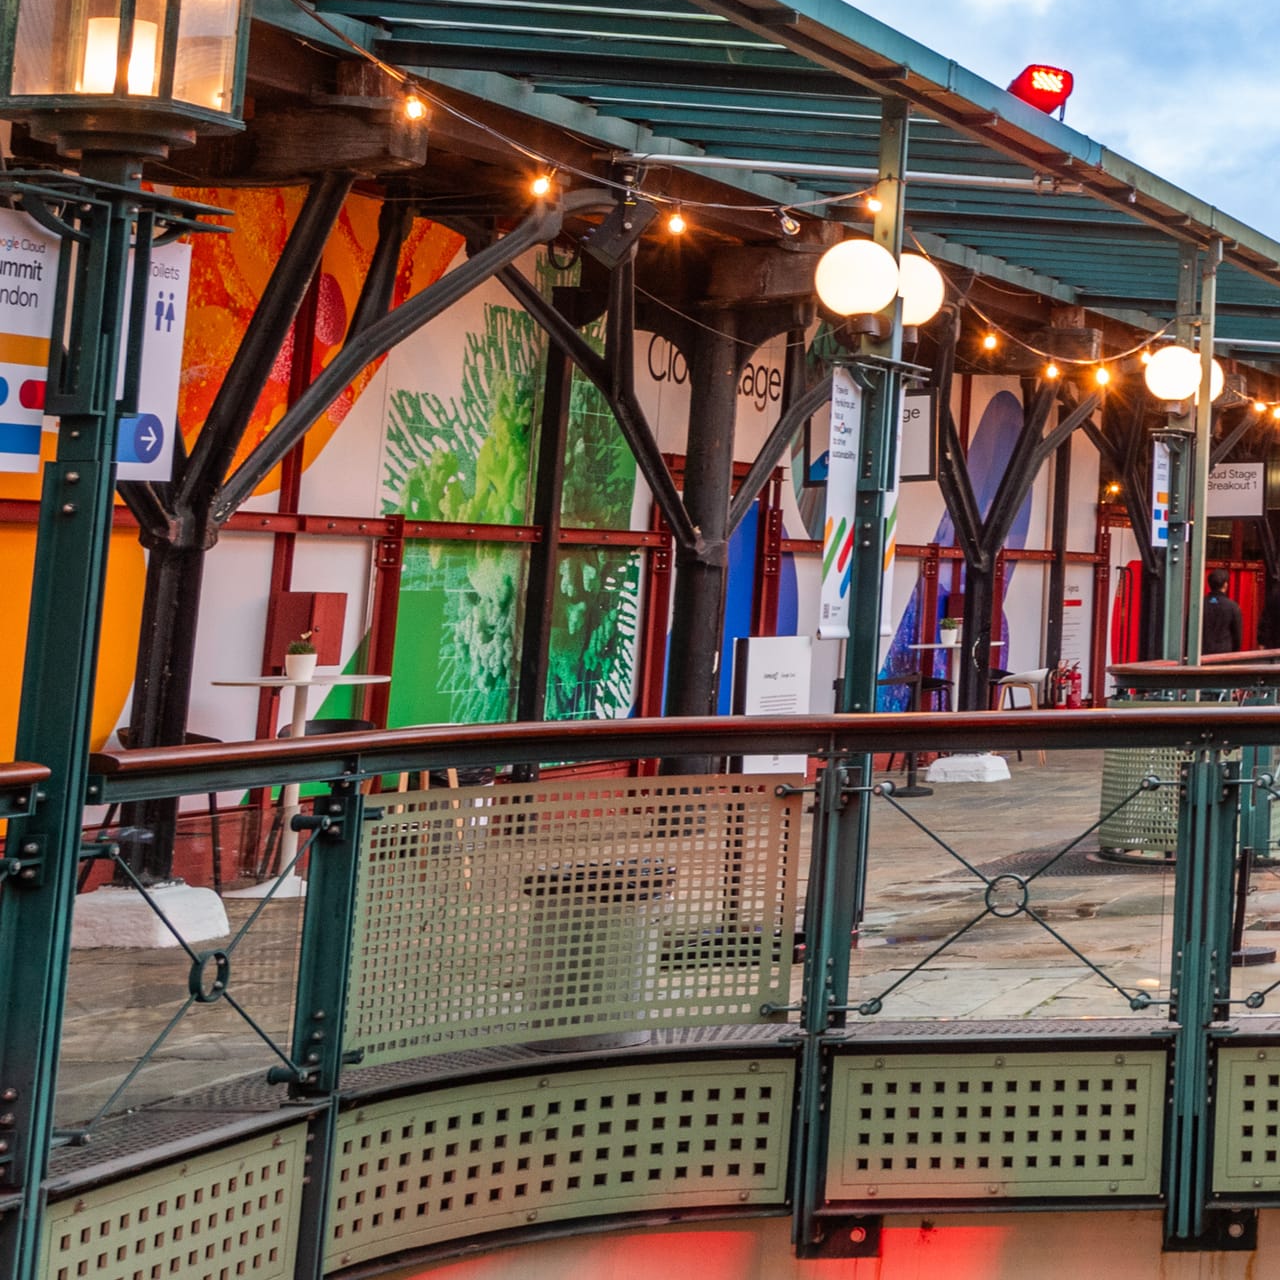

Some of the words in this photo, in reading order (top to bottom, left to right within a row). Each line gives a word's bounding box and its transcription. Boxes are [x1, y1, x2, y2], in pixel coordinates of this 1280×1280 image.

[0, 236, 19, 251] ogle
[21, 238, 46, 253] Cloud
[0, 259, 43, 281] mmit
[0, 285, 38, 308] ndon
[648, 333, 688, 384] Clo
[738, 363, 782, 412] age
[1208, 470, 1226, 480] oud
[1229, 469, 1257, 481] Stage
